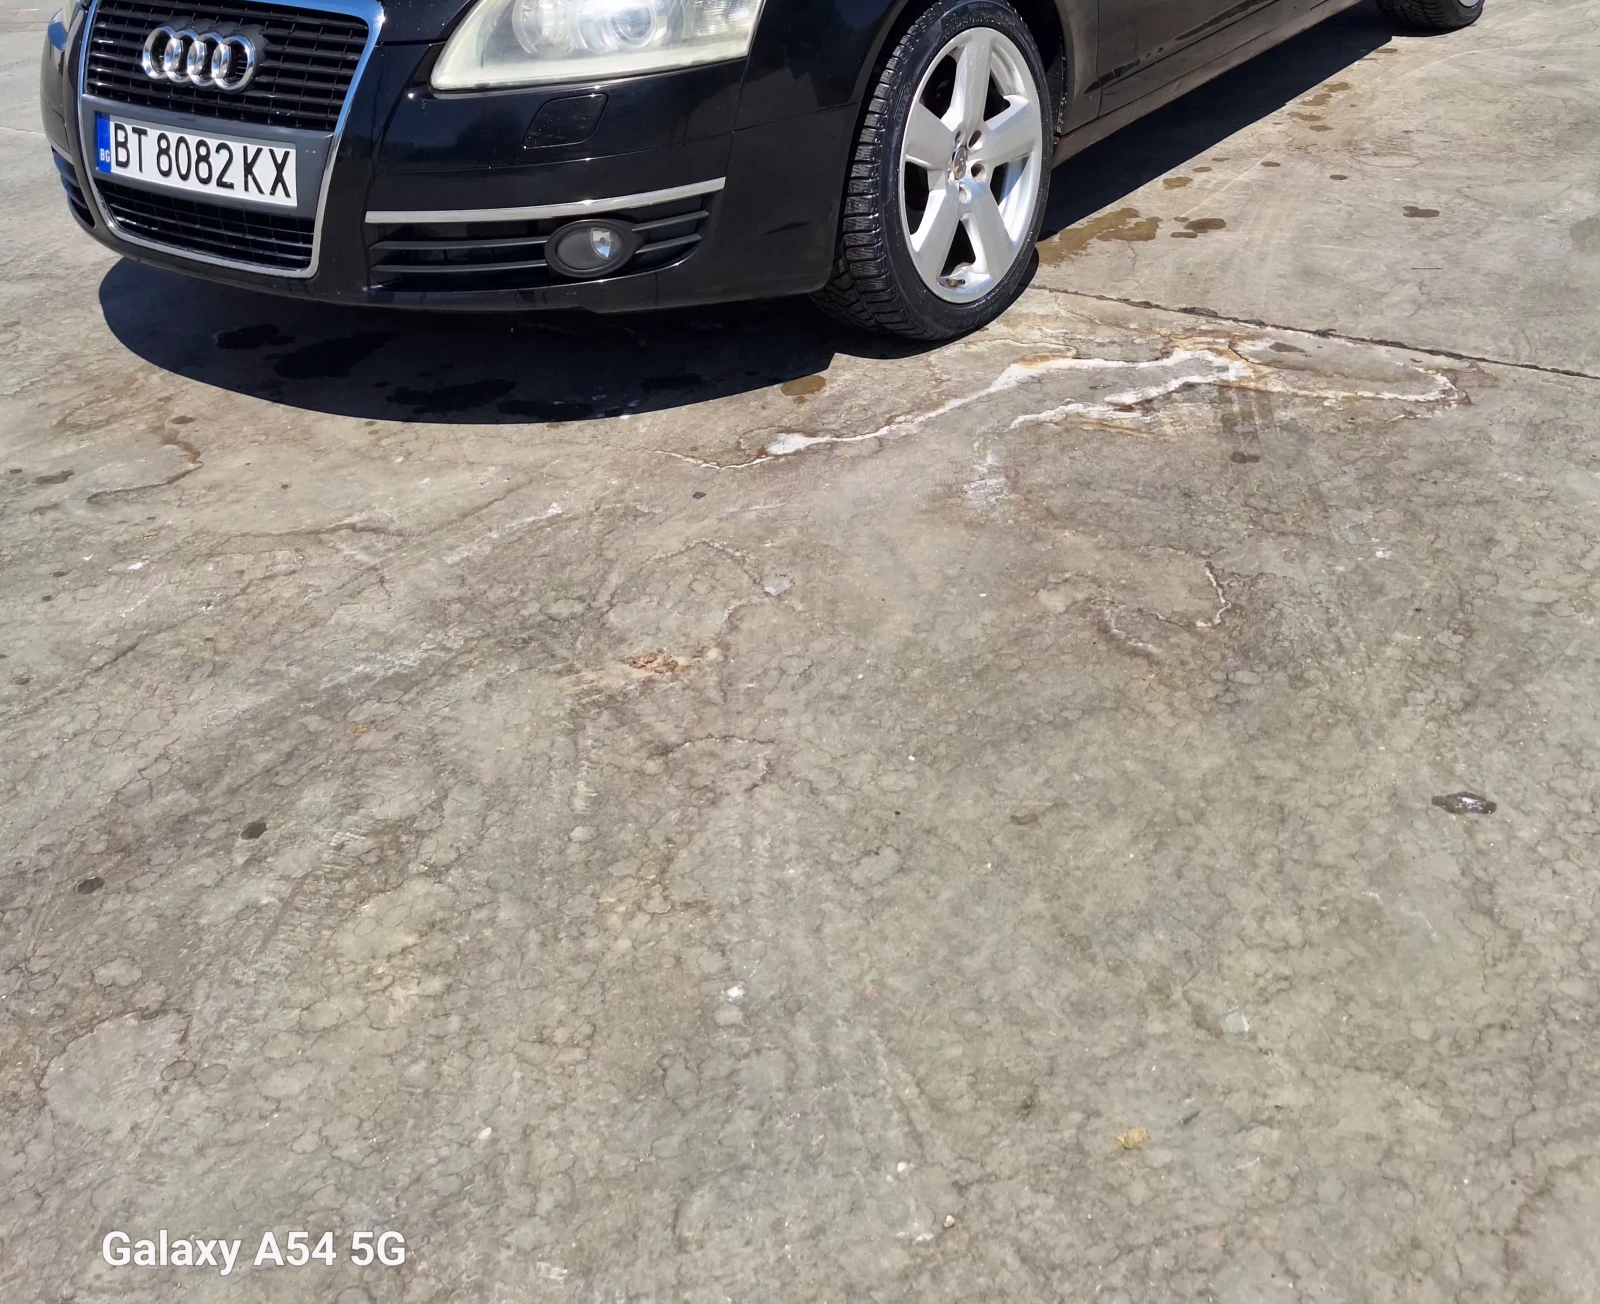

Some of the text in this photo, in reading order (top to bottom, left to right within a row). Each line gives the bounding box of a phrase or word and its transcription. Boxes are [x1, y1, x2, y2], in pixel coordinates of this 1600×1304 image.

[100, 147, 110, 163] BG
[114, 123, 291, 198] BT 8082 KX
